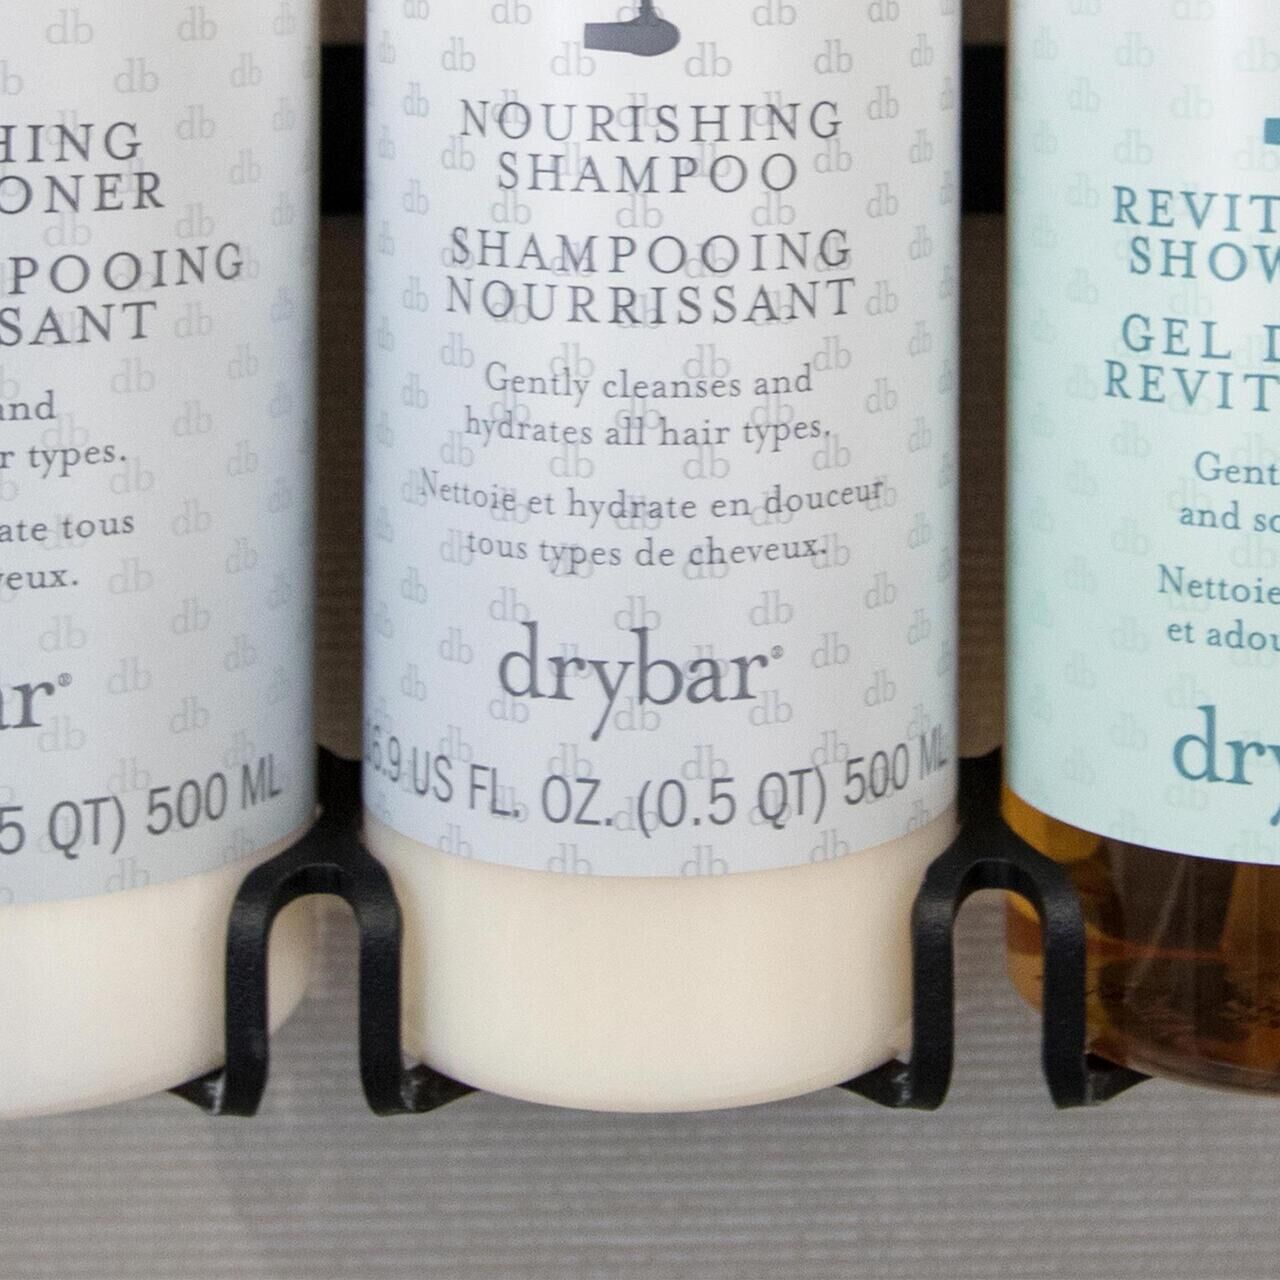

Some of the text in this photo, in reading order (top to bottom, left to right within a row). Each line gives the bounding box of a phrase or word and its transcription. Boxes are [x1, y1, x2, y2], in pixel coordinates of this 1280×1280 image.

[45, 9, 94, 44] db
[177, 6, 217, 41] db
[441, 36, 476, 72] db
[684, 41, 732, 77] db
[813, 39, 853, 74] db
[114, 57, 159, 93] db
[866, 85, 899, 120] db
[175, 105, 215, 140] db
[460, 98, 842, 144] NOURISHING
[497, 150, 798, 194] SHAMPOO
[866, 183, 898, 218] db
[450, 225, 851, 275] SHAMPOOING
[446, 275, 856, 326] NOURRISSANT
[865, 280, 898, 316] db
[440, 332, 474, 368] db
[813, 335, 851, 371] db
[1120, 312, 1232, 364] GEL
[111, 358, 154, 393] db
[484, 360, 813, 408] Gently cleanses and
[865, 378, 897, 414] db
[173, 401, 211, 436] db
[464, 405, 831, 454] hydrates all hair types.
[27, 444, 127, 480] types.
[419, 467, 885, 529] Nettoie et hydrate en douceur
[60, 515, 135, 541] tous
[1179, 503, 1242, 531] and
[465, 532, 828, 576] tous types de cheveux.
[748, 590, 794, 623] db
[864, 572, 897, 609] db
[439, 627, 473, 664] db
[811, 632, 850, 668] db
[1166, 622, 1195, 645] et
[411, 747, 454, 804] US
[469, 763, 521, 819] FL.
[541, 773, 614, 827] OZ.
[636, 776, 737, 839] (0.5
[756, 768, 827, 831] QT)
[843, 742, 909, 806] 500
[918, 727, 949, 780] ML
[47, 795, 126, 861] QT)
[146, 771, 228, 836] 500
[241, 753, 282, 810] ML
